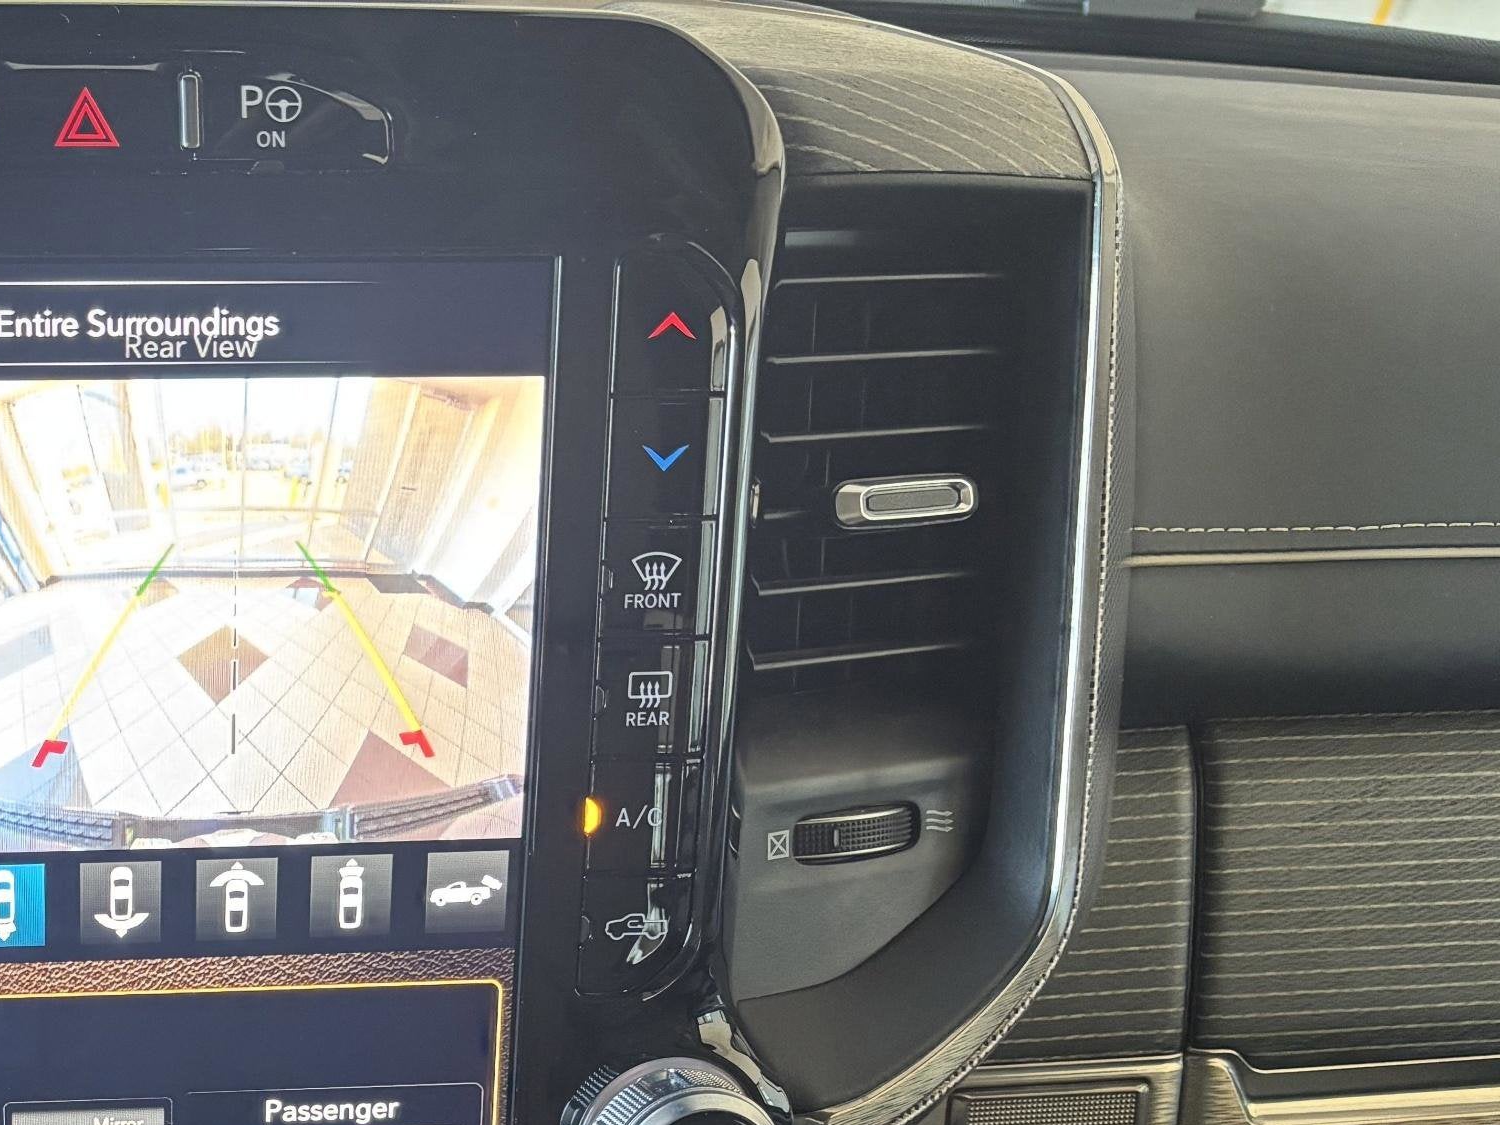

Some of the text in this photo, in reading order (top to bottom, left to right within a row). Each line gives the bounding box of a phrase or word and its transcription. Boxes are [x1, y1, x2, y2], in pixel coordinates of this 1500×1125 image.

[241, 86, 264, 119] P
[256, 131, 286, 148] ON
[87, 310, 280, 345] Surroundings
[125, 334, 257, 359] Rear View
[624, 593, 681, 609] FRONT
[625, 712, 669, 726] REAR
[616, 805, 662, 828] A/C
[264, 1099, 399, 1125] Passenger
